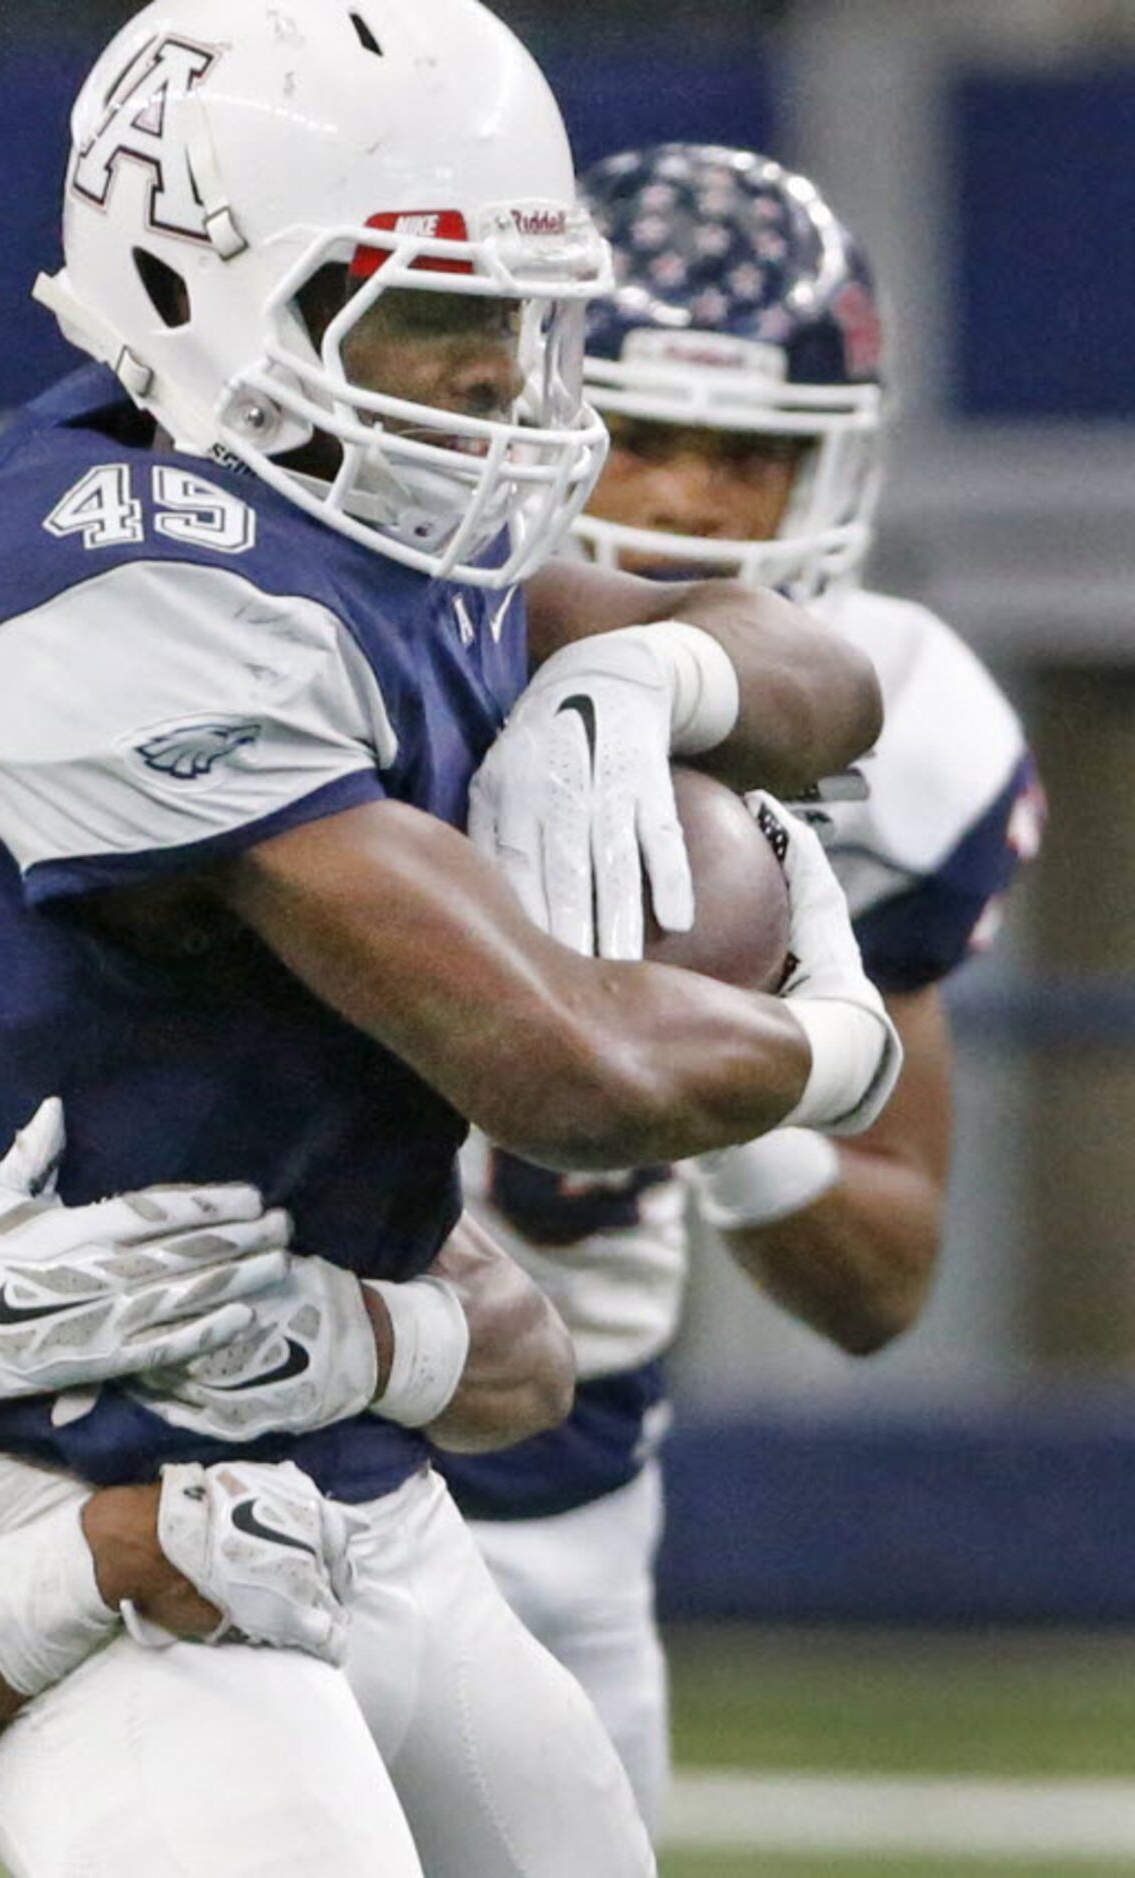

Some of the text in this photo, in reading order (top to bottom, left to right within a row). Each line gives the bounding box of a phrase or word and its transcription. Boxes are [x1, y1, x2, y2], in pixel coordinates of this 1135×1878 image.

[394, 214, 439, 238] NIKE
[512, 209, 566, 235] Riddell
[42, 463, 256, 554] 45
